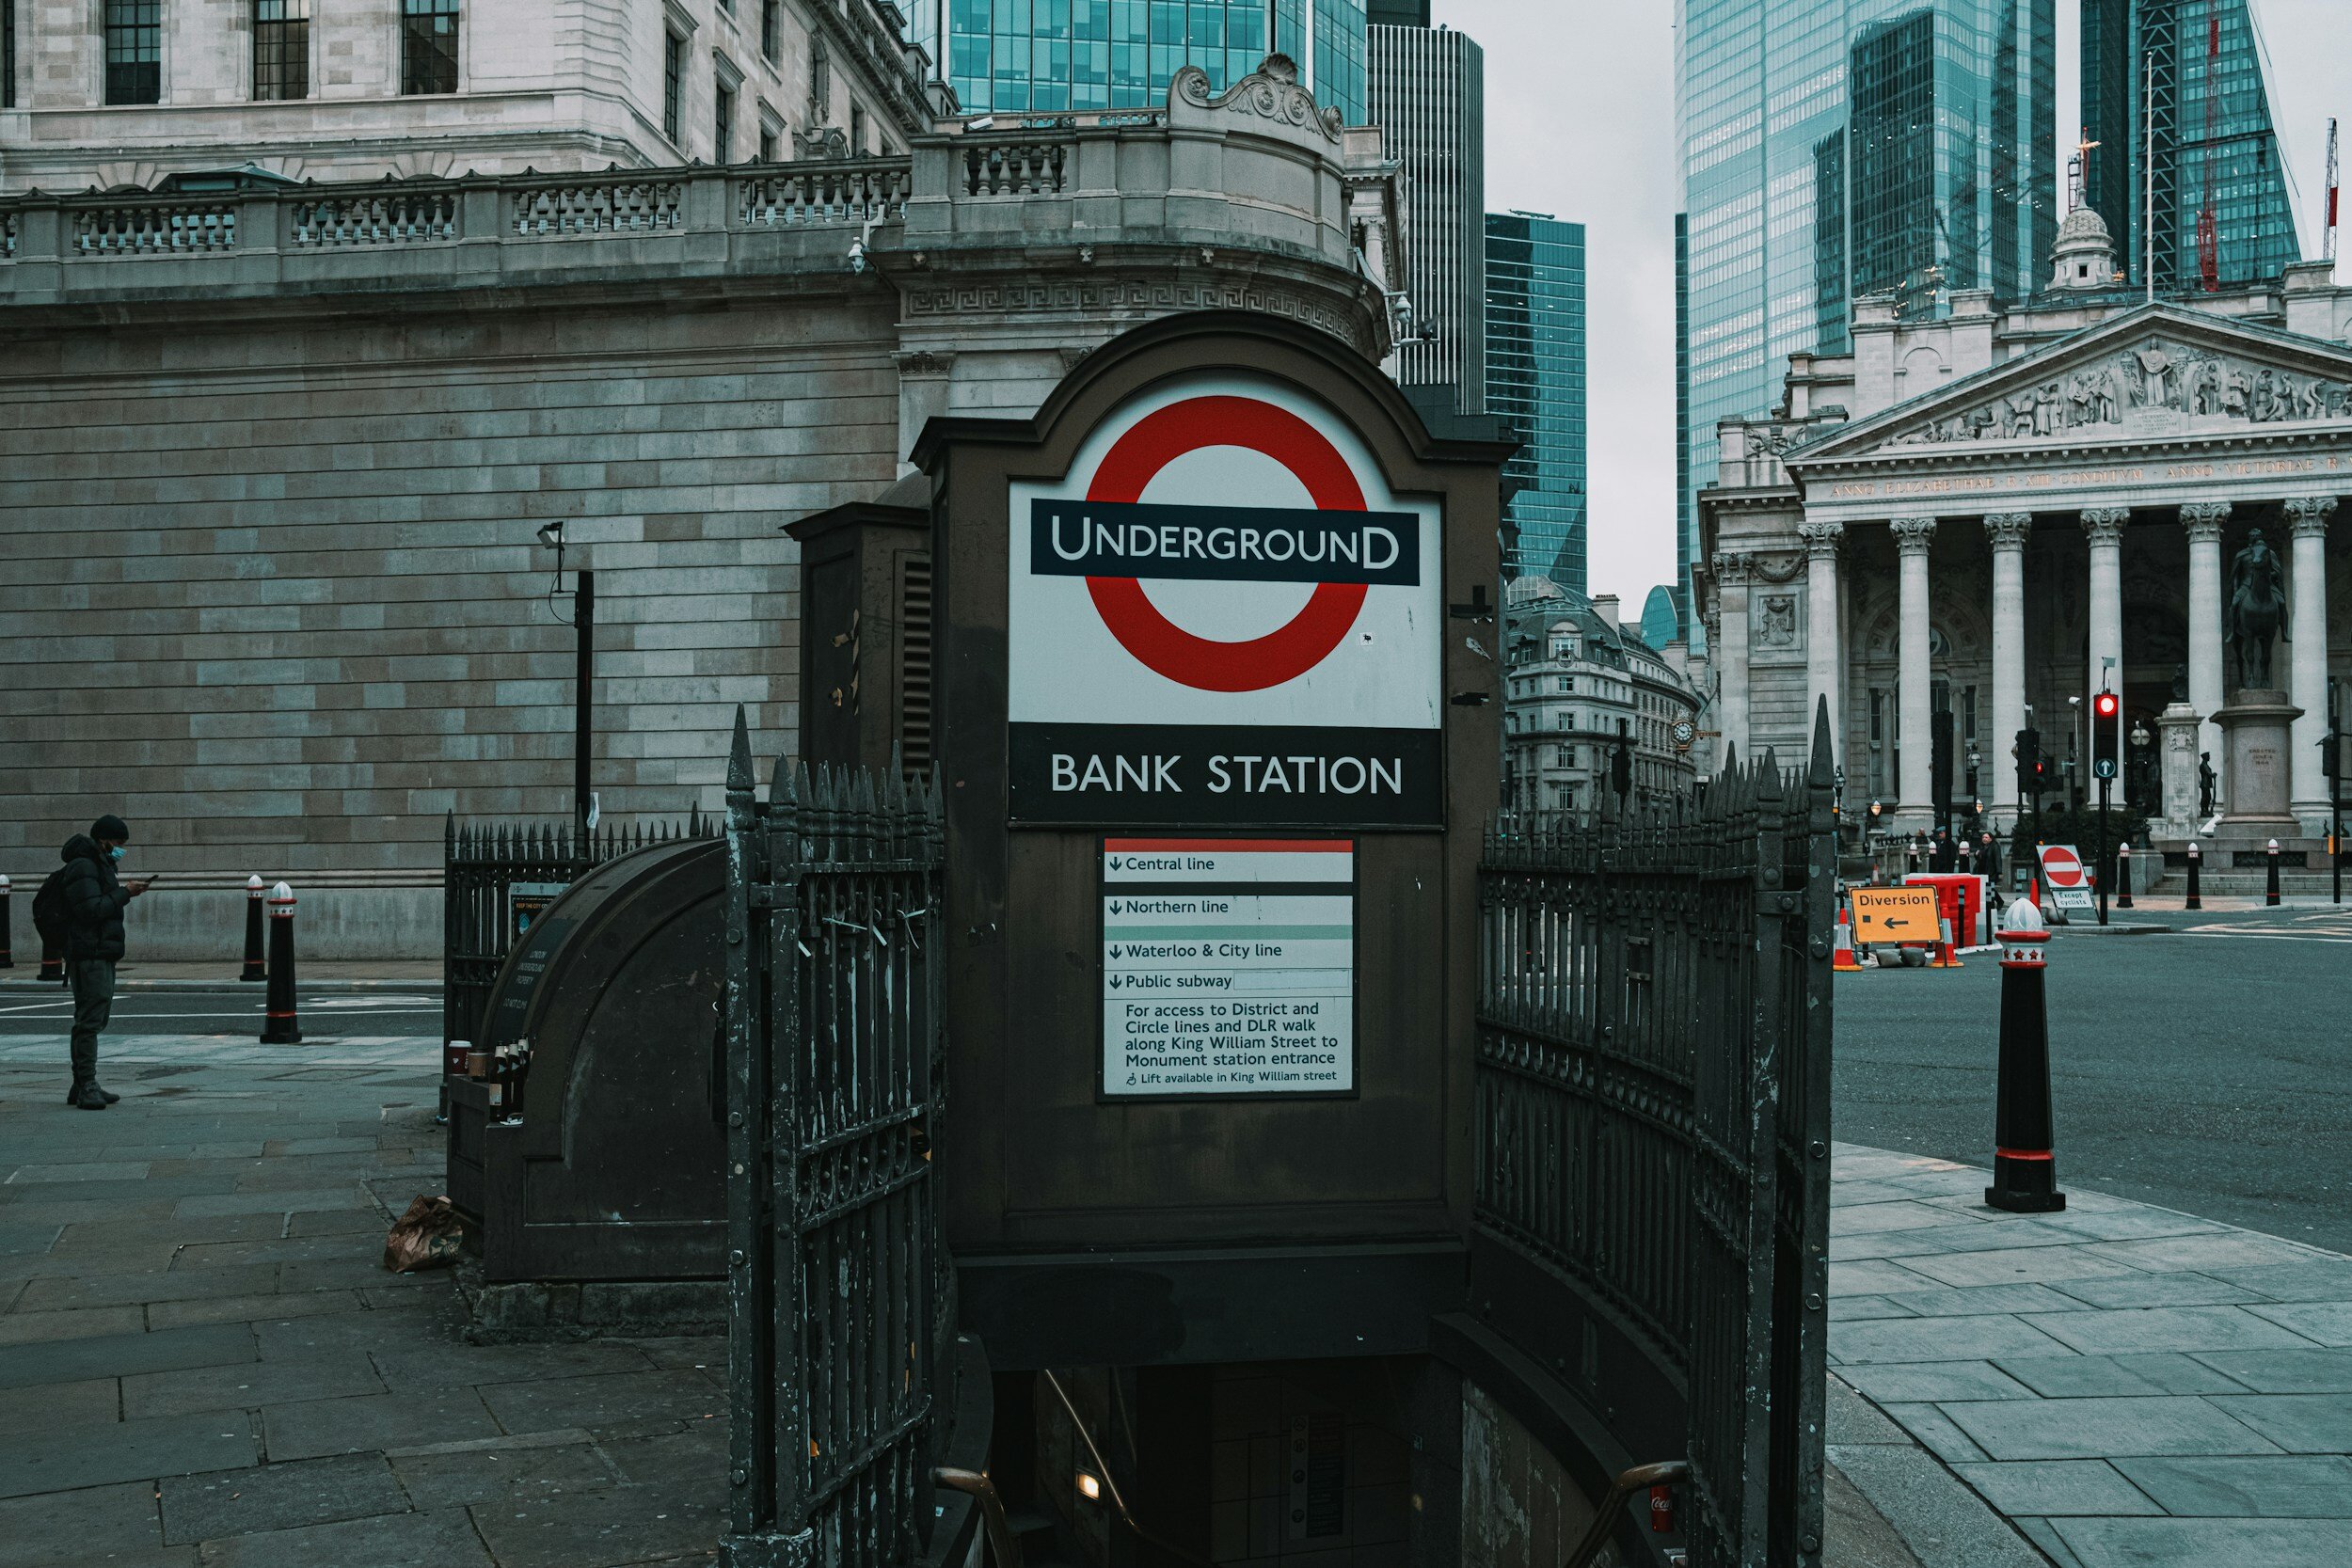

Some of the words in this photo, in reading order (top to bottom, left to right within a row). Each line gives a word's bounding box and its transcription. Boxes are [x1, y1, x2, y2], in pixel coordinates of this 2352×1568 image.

[1831, 483, 1875, 497] ANNO
[1885, 476, 1995, 495] ELIZABETHAE
[2006, 475, 2017, 487] R
[2059, 468, 2144, 484] CONDITVM
[2166, 465, 2214, 478] ANNO
[2224, 458, 2316, 475] VICTORIAE
[1051, 515, 1400, 570] UNDERGROUND
[1052, 753, 1183, 793] BANK
[1206, 754, 1402, 795] STATION
[1125, 857, 1183, 870] Central
[1187, 857, 1215, 870] line
[1859, 894, 1931, 907] Diversion
[2058, 892, 2083, 900] Except
[1126, 900, 1197, 913] Northern
[1201, 900, 1229, 913] line
[1125, 943, 1197, 958] Waterloo
[1202, 943, 1214, 957] &
[1218, 943, 1250, 959] City
[1255, 943, 1282, 957] line
[1126, 974, 1171, 989] Public
[1176, 974, 1232, 990] subway
[1126, 1004, 1150, 1018] For
[1154, 1006, 1204, 1017] access
[1210, 1005, 1227, 1016] to
[1232, 1003, 1288, 1016] District
[1293, 1002, 1319, 1015] and
[1125, 1021, 1169, 1034] Circle
[1174, 1020, 1210, 1034] lines
[1215, 1019, 1242, 1033] and
[1248, 1019, 1278, 1032] DLR
[1282, 1019, 1316, 1032] walk
[1125, 1037, 1167, 1053] along
[1171, 1037, 1204, 1053] King
[1209, 1036, 1265, 1049] William
[1270, 1035, 1317, 1049] Street
[1321, 1036, 1338, 1048] to
[1126, 1053, 1208, 1068] Monument
[1213, 1053, 1266, 1066] station
[1271, 1053, 1336, 1065] entrance
[1141, 1073, 1162, 1084] Lift
[1165, 1072, 1214, 1084] available
[1216, 1072, 1227, 1083] in
[1231, 1071, 1255, 1085] King
[1258, 1071, 1300, 1082] William
[1303, 1070, 1337, 1081] street
